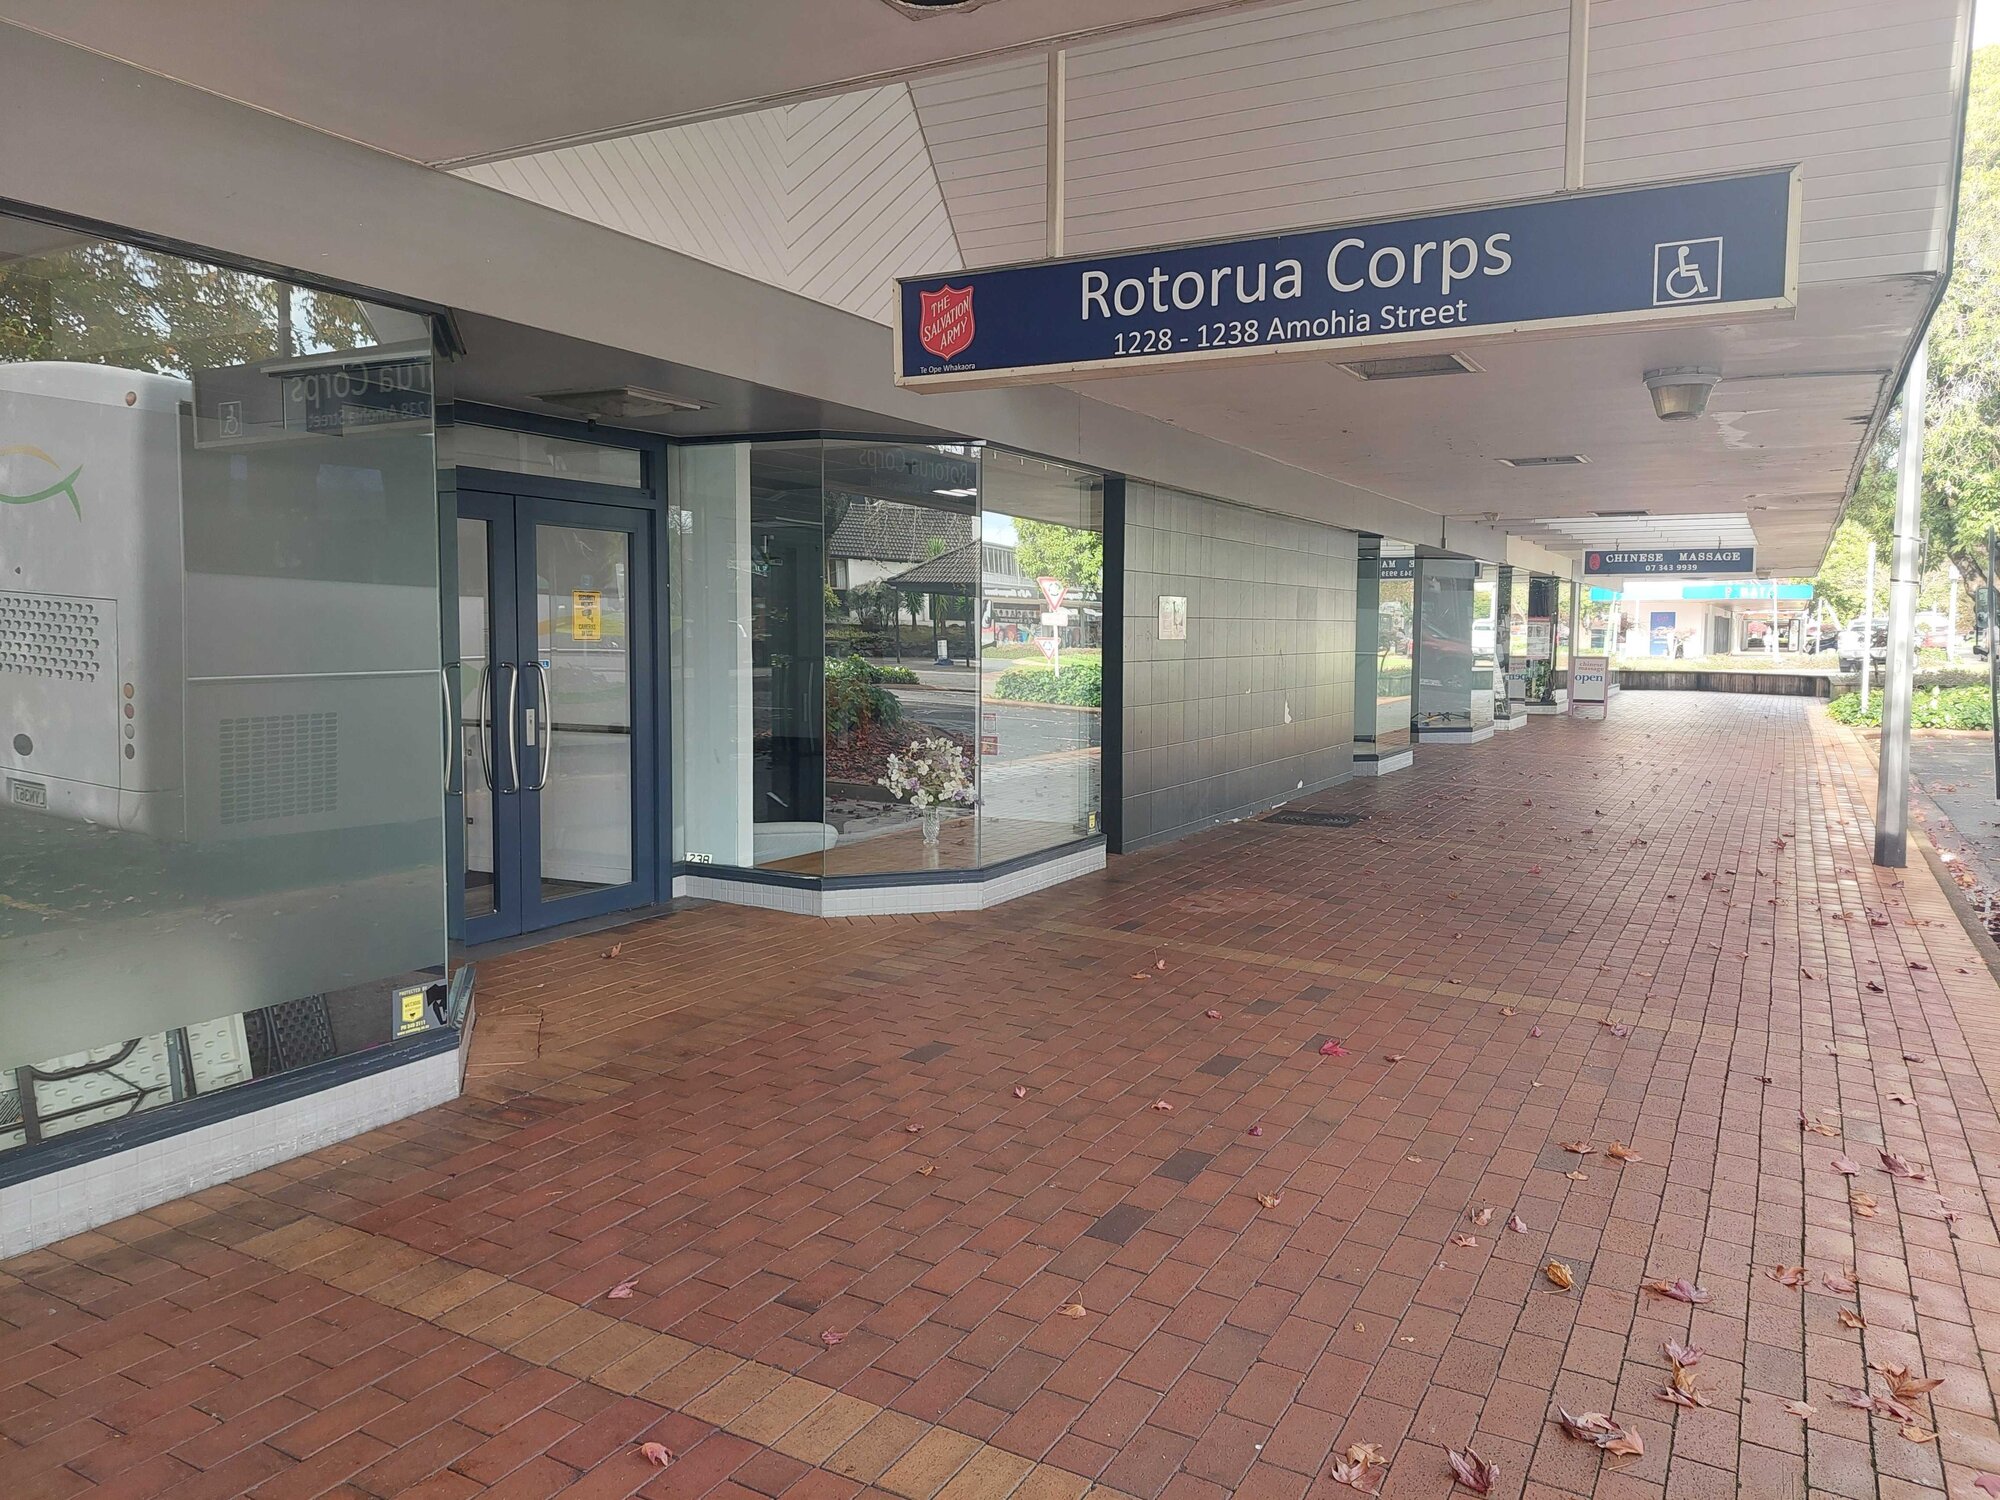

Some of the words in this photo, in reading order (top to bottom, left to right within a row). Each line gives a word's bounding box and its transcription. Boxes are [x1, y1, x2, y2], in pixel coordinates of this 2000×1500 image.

[1081, 257, 1302, 320] Rotorua
[1327, 233, 1512, 295] Corps
[931, 294, 951, 318] THE
[924, 295, 970, 342] SALVATION
[1114, 328, 1172, 355] 1228
[1197, 319, 1259, 347] 1238
[1266, 309, 1371, 341] Amohia
[1380, 299, 1468, 330] Street
[940, 316, 968, 350] ARMY
[920, 366, 927, 374] Te
[929, 365, 942, 374] Ope
[943, 363, 976, 372] Whakaora
[1605, 553, 1664, 563] CHINESE
[1679, 551, 1741, 561] MASSAGE
[1676, 563, 1698, 571] 9939
[1575, 674, 1603, 684] open
